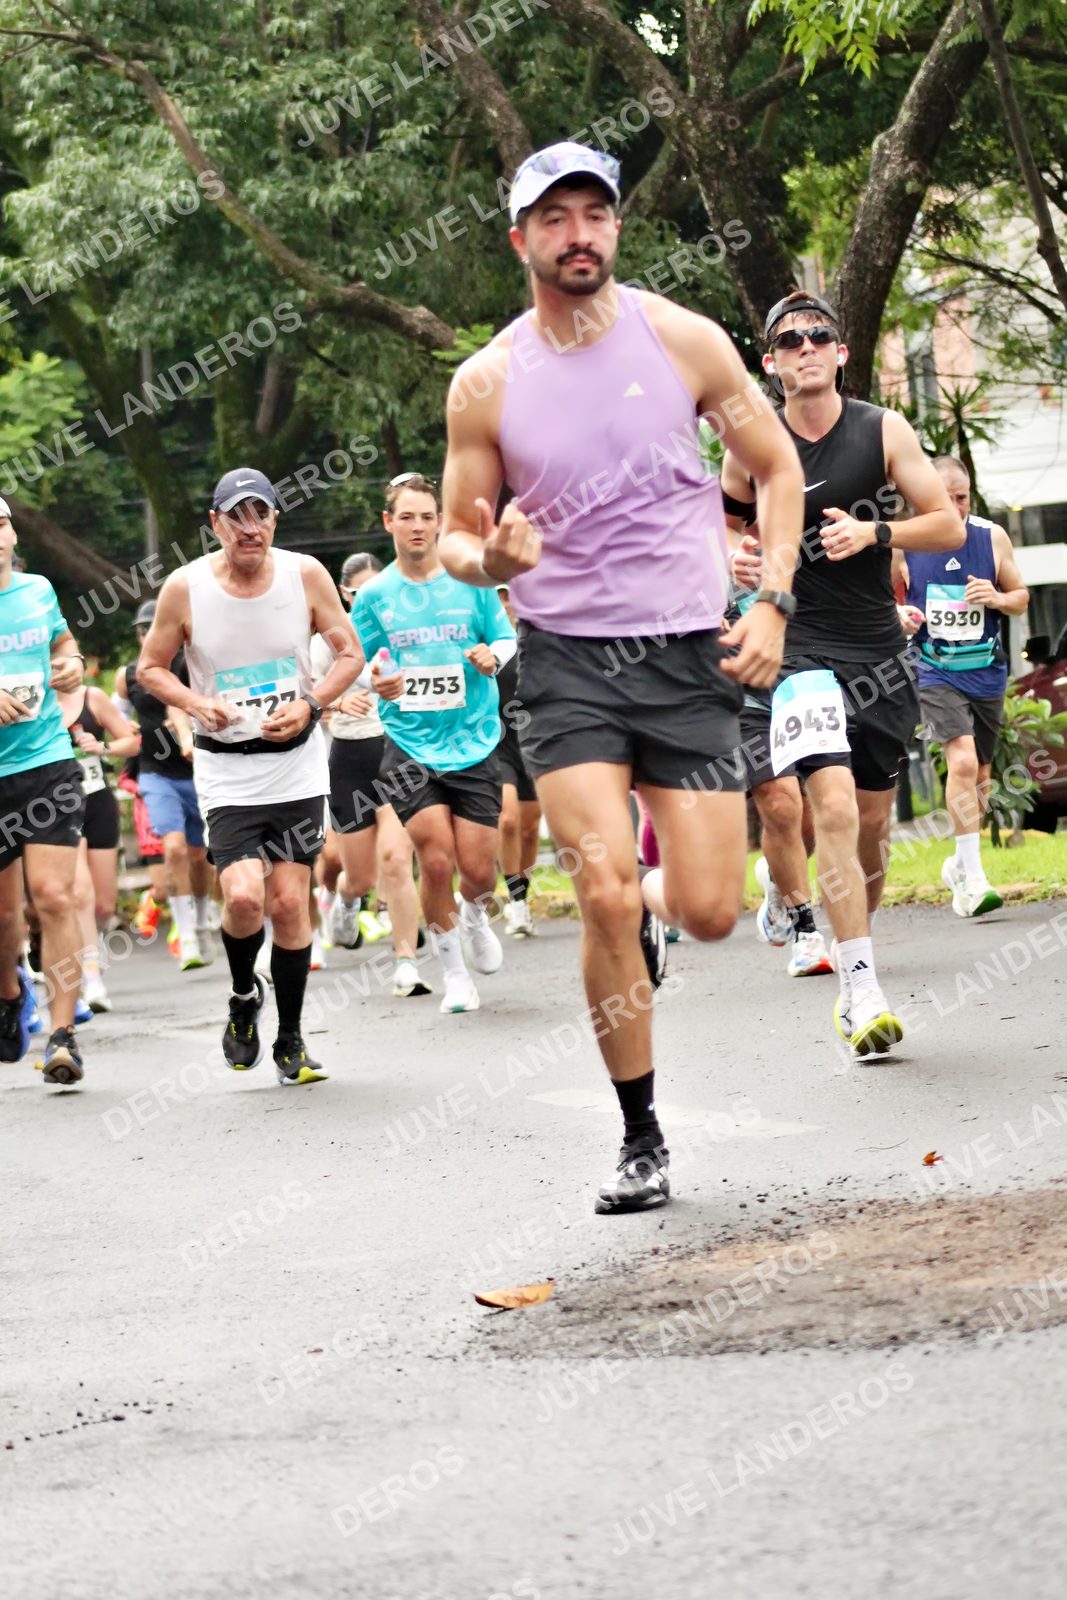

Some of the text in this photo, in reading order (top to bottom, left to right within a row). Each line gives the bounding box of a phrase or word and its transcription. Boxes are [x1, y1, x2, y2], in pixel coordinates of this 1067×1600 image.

[930, 610, 981, 627] 3930
[387, 624, 468, 650] PERDURA
[406, 676, 460, 696] 2753
[774, 706, 840, 749] 4943
